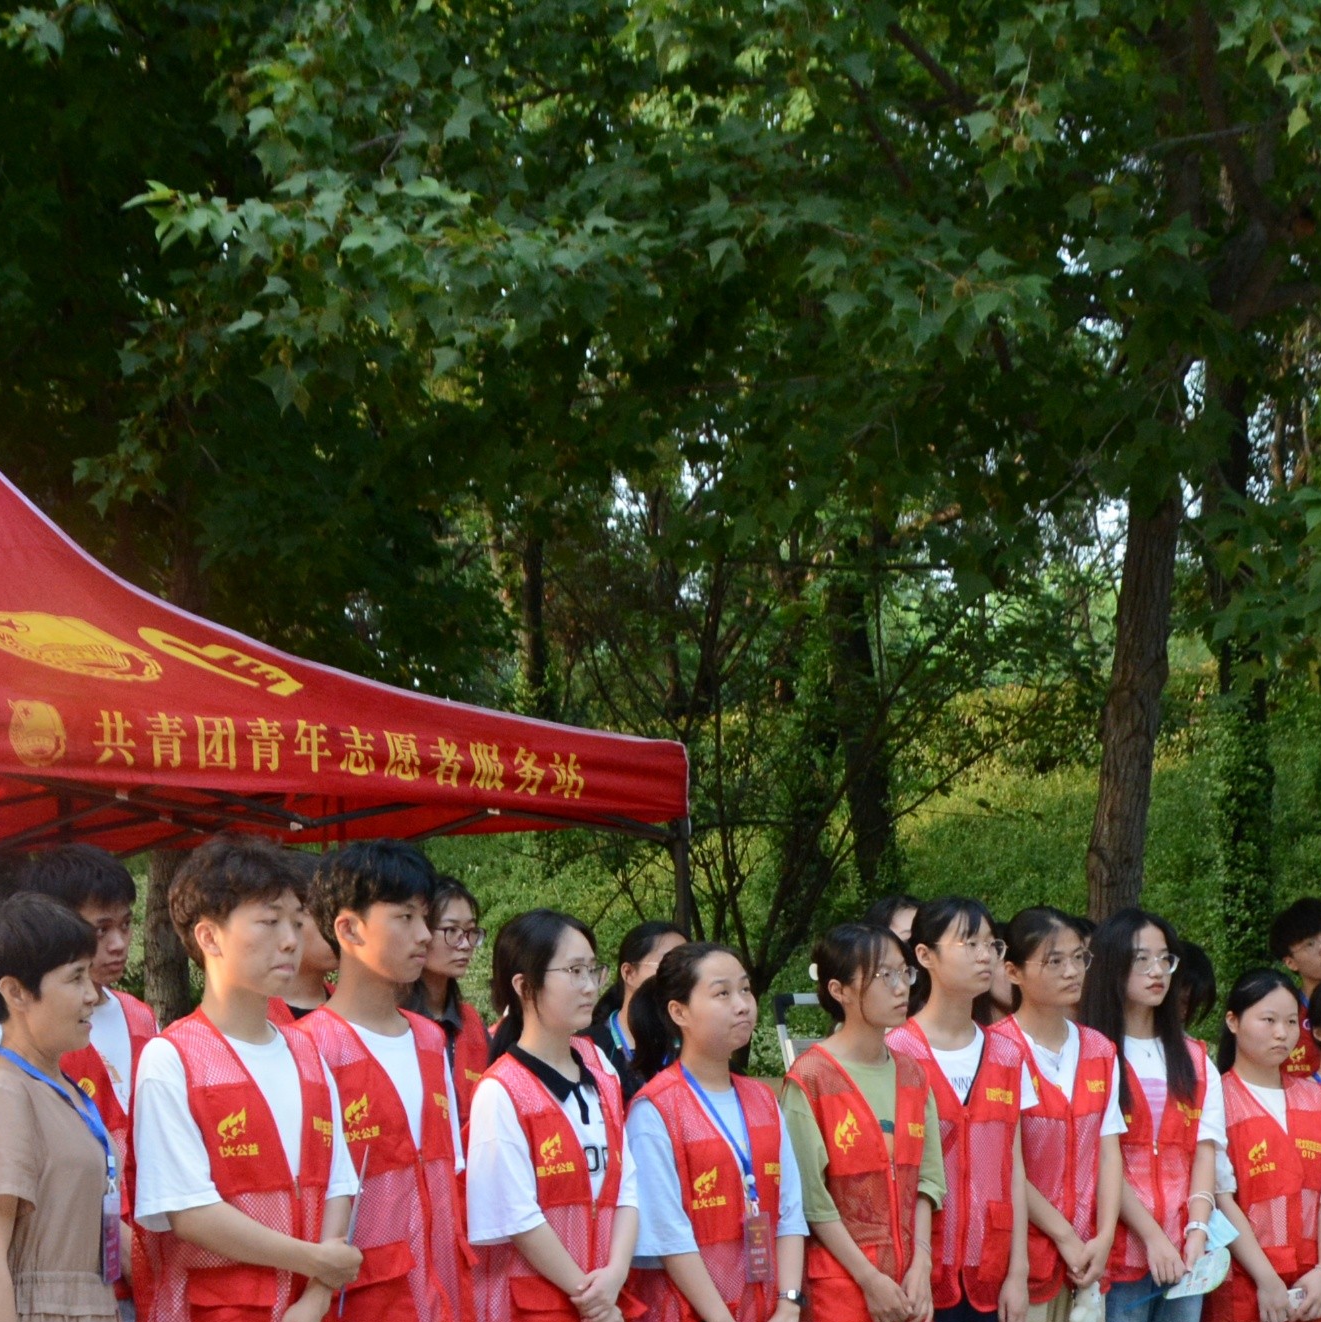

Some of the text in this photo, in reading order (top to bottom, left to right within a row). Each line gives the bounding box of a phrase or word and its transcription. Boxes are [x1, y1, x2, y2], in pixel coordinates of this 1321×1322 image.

[93, 710, 585, 799] 共青团青年志愿者服务站
[537, 1161, 576, 1178] 星火公益
